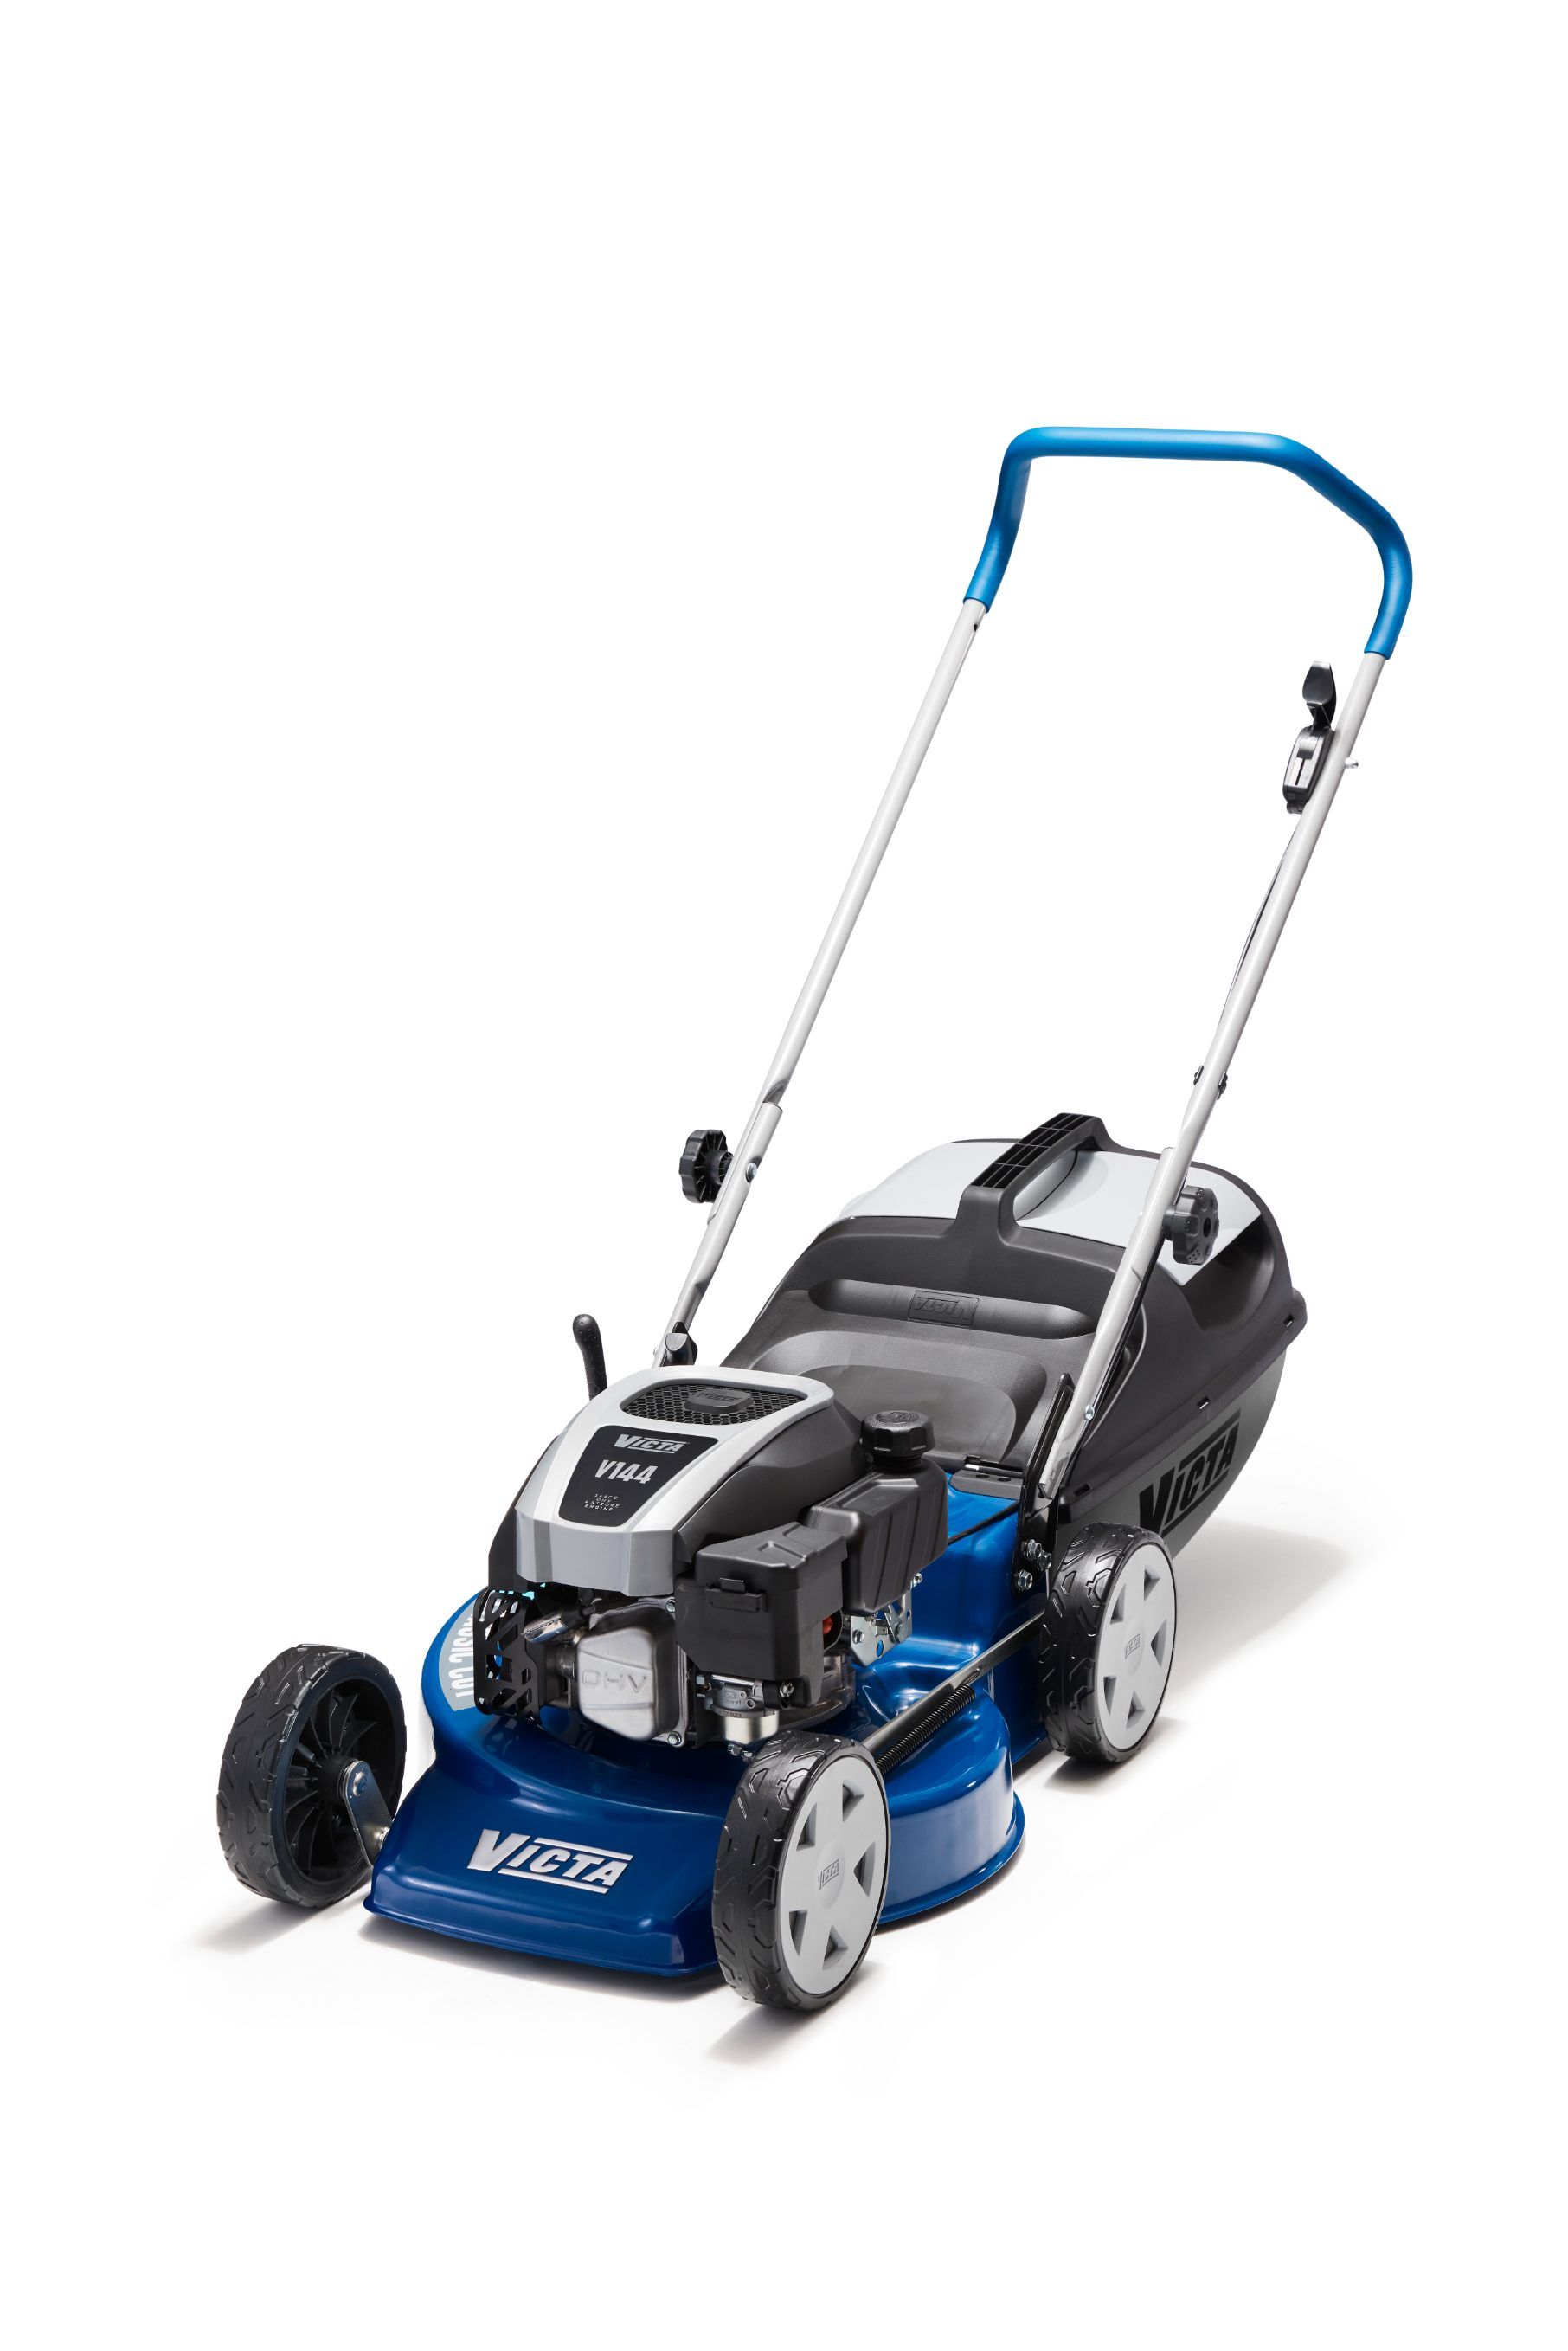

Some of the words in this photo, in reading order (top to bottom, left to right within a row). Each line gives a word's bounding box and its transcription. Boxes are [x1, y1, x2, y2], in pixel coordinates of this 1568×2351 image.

[614, 1433, 688, 1453] VICTA
[594, 1459, 658, 1484] V144
[1140, 1411, 1240, 1536] VICTA
[448, 1612, 474, 1663] SSIC
[582, 1670, 647, 1693] OHV
[466, 1828, 633, 1894] VICTA
[817, 1858, 839, 1891] VICTA
